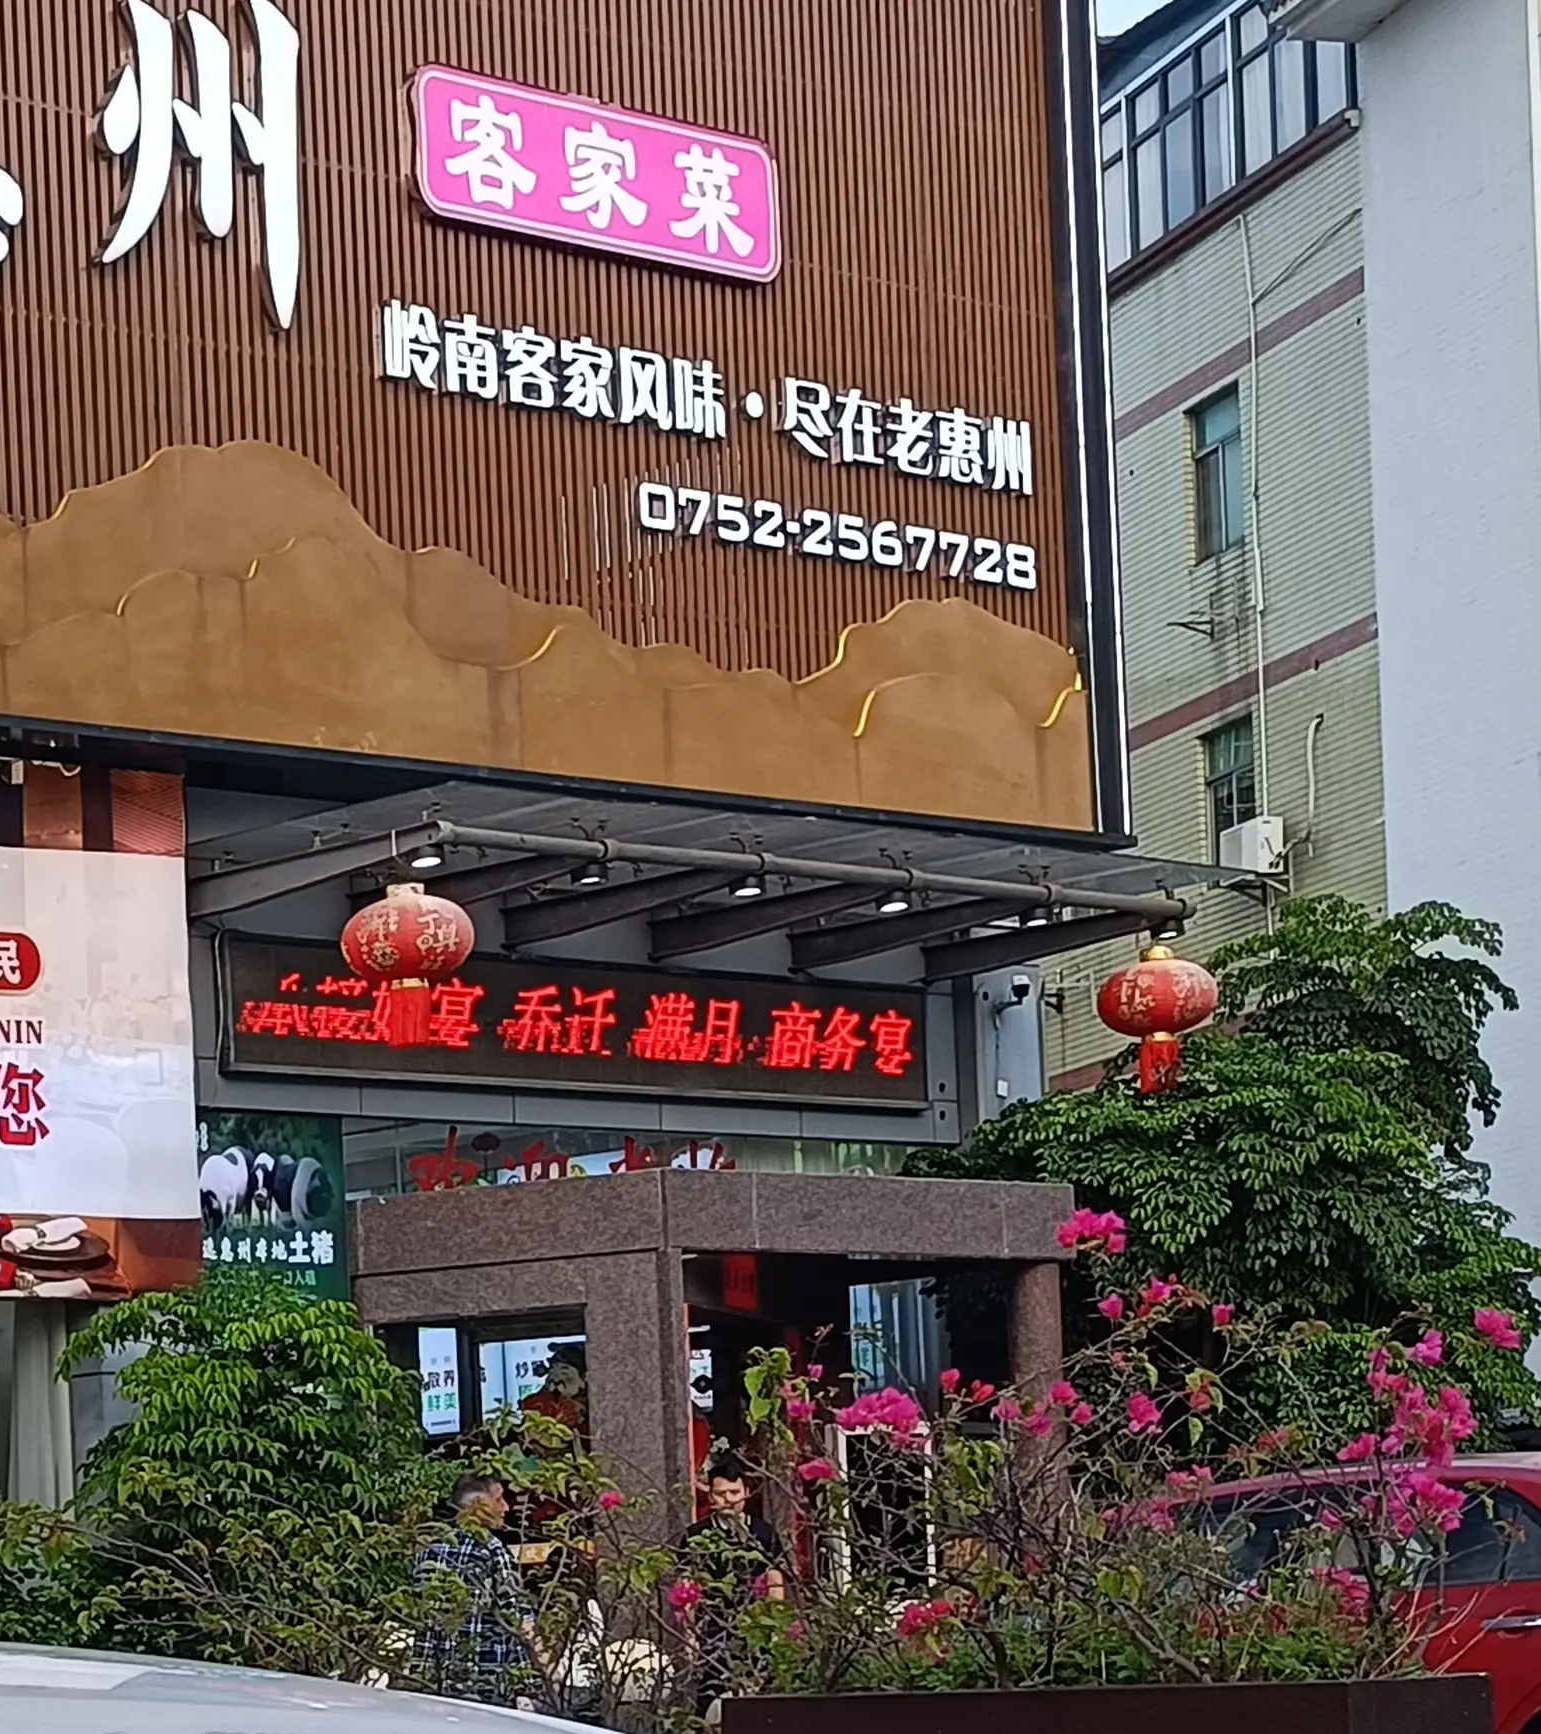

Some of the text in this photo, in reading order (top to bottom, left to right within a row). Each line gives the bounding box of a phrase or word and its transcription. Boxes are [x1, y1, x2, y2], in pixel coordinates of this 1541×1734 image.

[443, 95, 755, 257] 客家菜
[638, 481, 1036, 590] 0752-2567728
